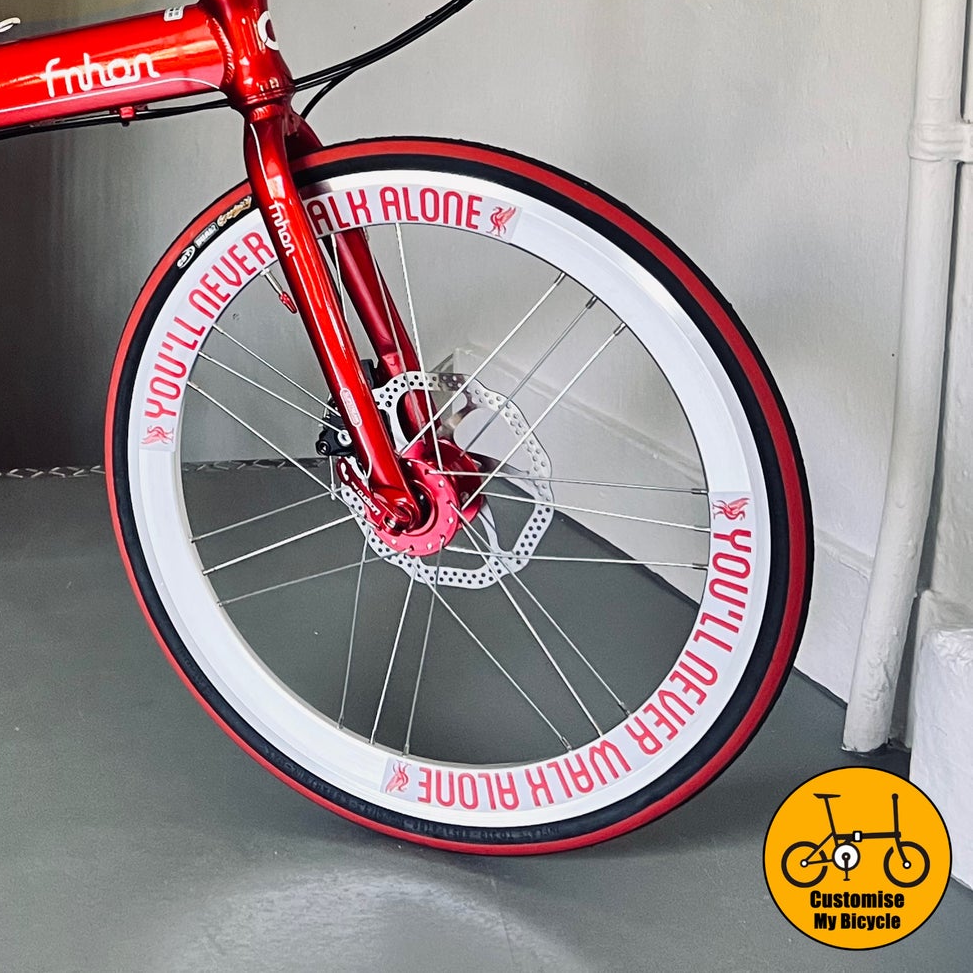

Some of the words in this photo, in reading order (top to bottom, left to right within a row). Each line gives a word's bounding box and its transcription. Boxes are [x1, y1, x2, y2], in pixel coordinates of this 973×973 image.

[39, 52, 161, 98] fnhon
[268, 200, 295, 257] fnhon
[144, 316, 206, 418] YOU'LL
[188, 231, 275, 319] NEVER
[306, 188, 372, 235] ALK
[379, 186, 483, 230] ALONE
[693, 529, 752, 653] YOU'LL
[624, 649, 718, 756] NEVER
[417, 766, 520, 811] ALONE
[524, 739, 632, 807] WALK
